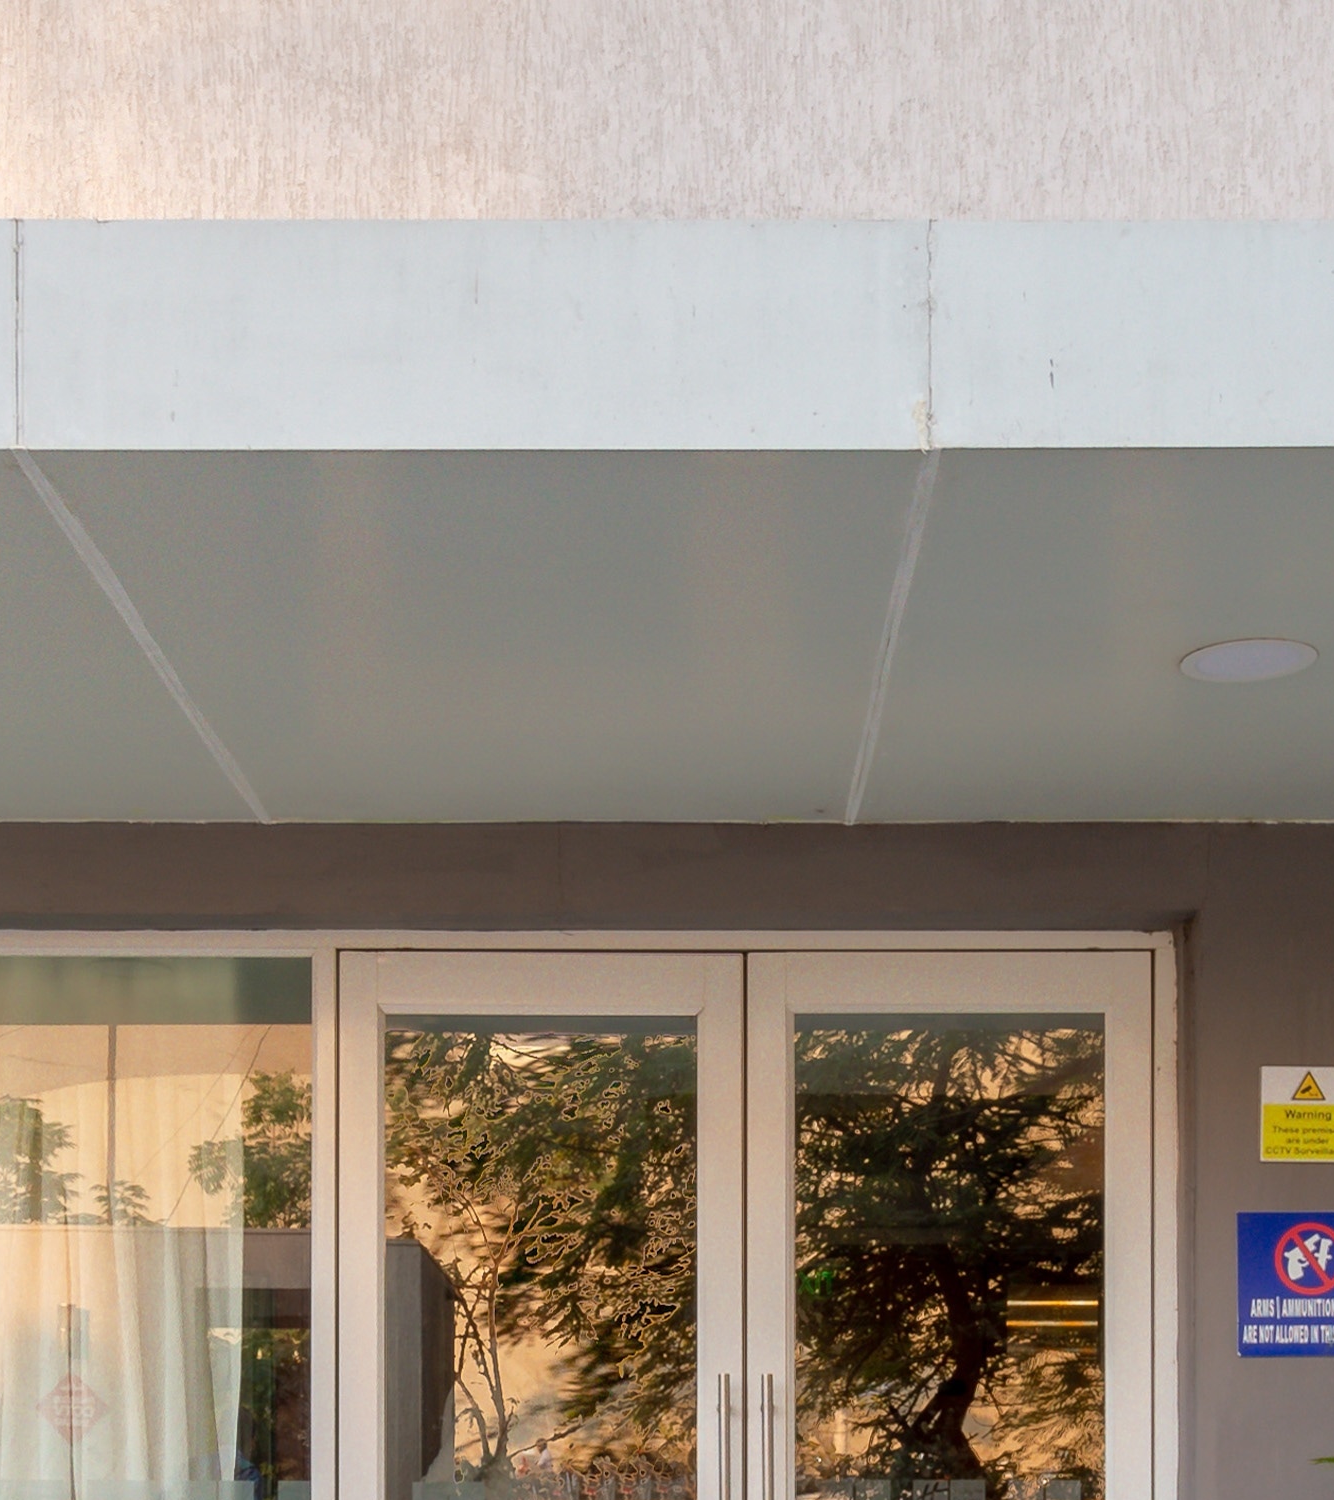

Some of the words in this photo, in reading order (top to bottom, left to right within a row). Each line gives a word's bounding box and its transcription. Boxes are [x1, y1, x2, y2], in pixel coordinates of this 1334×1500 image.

[1285, 1109, 1332, 1121] Warning
[1272, 1126, 1300, 1134] These
[1265, 1146, 1292, 1155] CCTV
[1250, 1298, 1275, 1318] ARMS
[1242, 1324, 1258, 1344] ARE
[1258, 1324, 1275, 1344] NOT
[1275, 1324, 1310, 1344] ALLOWED
[1310, 1324, 1320, 1344] IN
